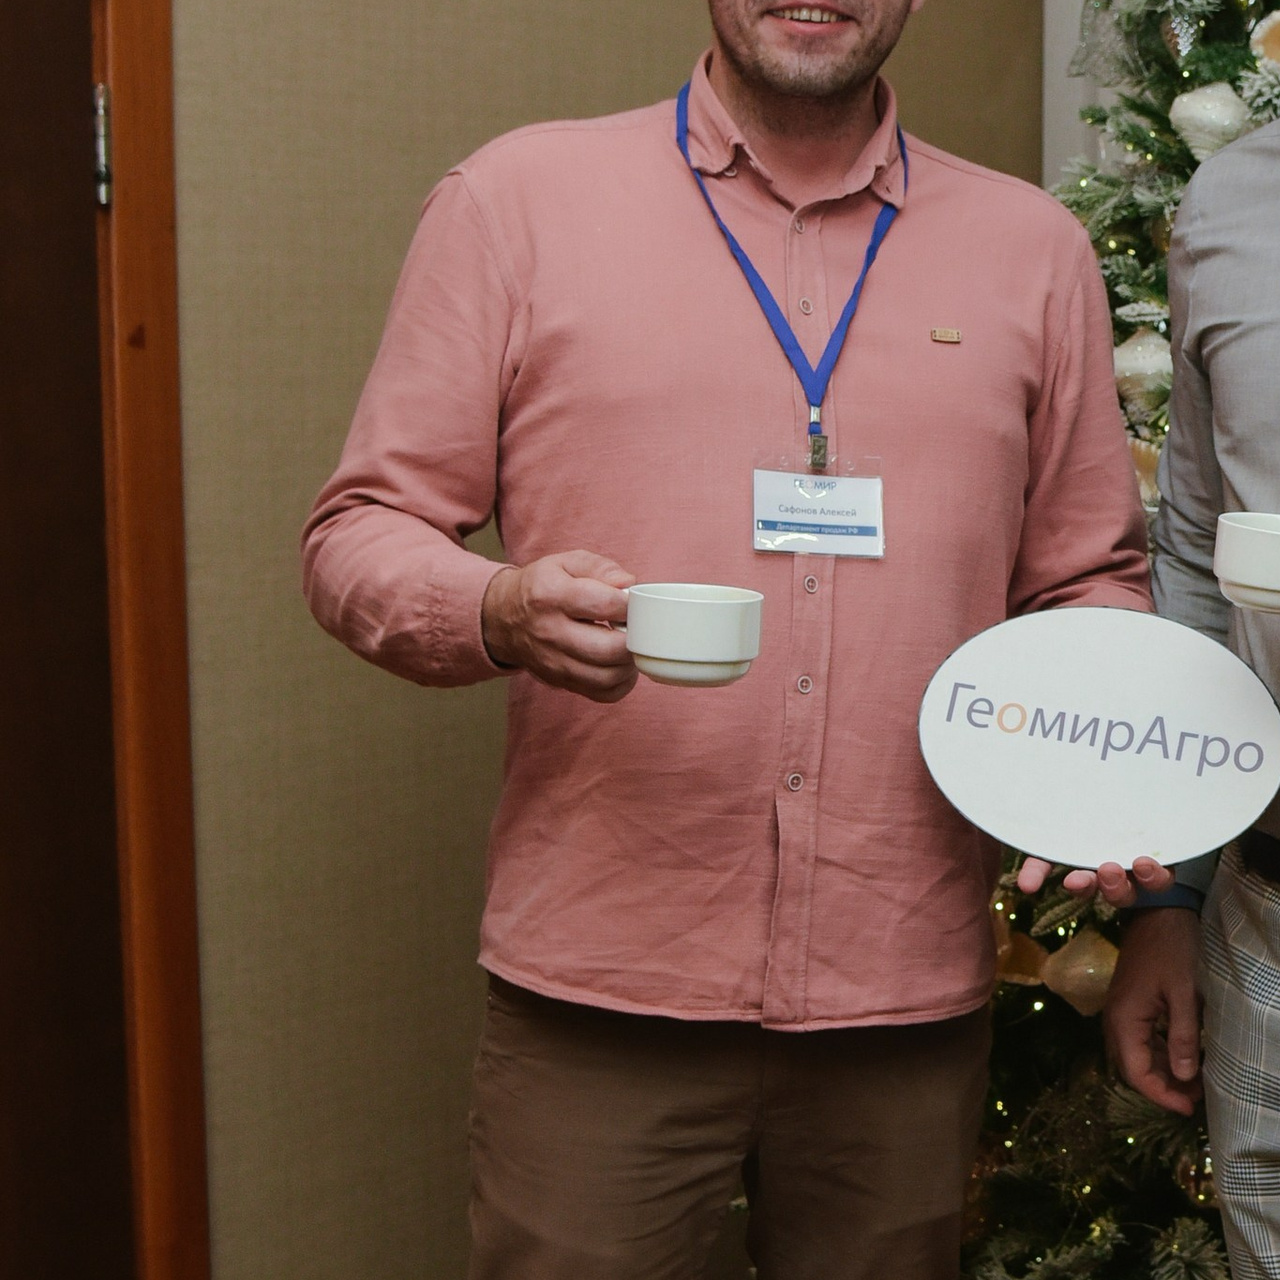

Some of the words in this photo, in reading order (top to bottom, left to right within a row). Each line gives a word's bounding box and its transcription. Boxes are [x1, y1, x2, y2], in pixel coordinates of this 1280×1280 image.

[794, 479, 837, 491] ГЕОМИР
[778, 505, 817, 515] Сафонов
[820, 508, 857, 517] Алексей
[776, 523, 820, 533] Департамент
[821, 526, 847, 535] продаж
[945, 682, 1265, 776] ГеомирАгро
